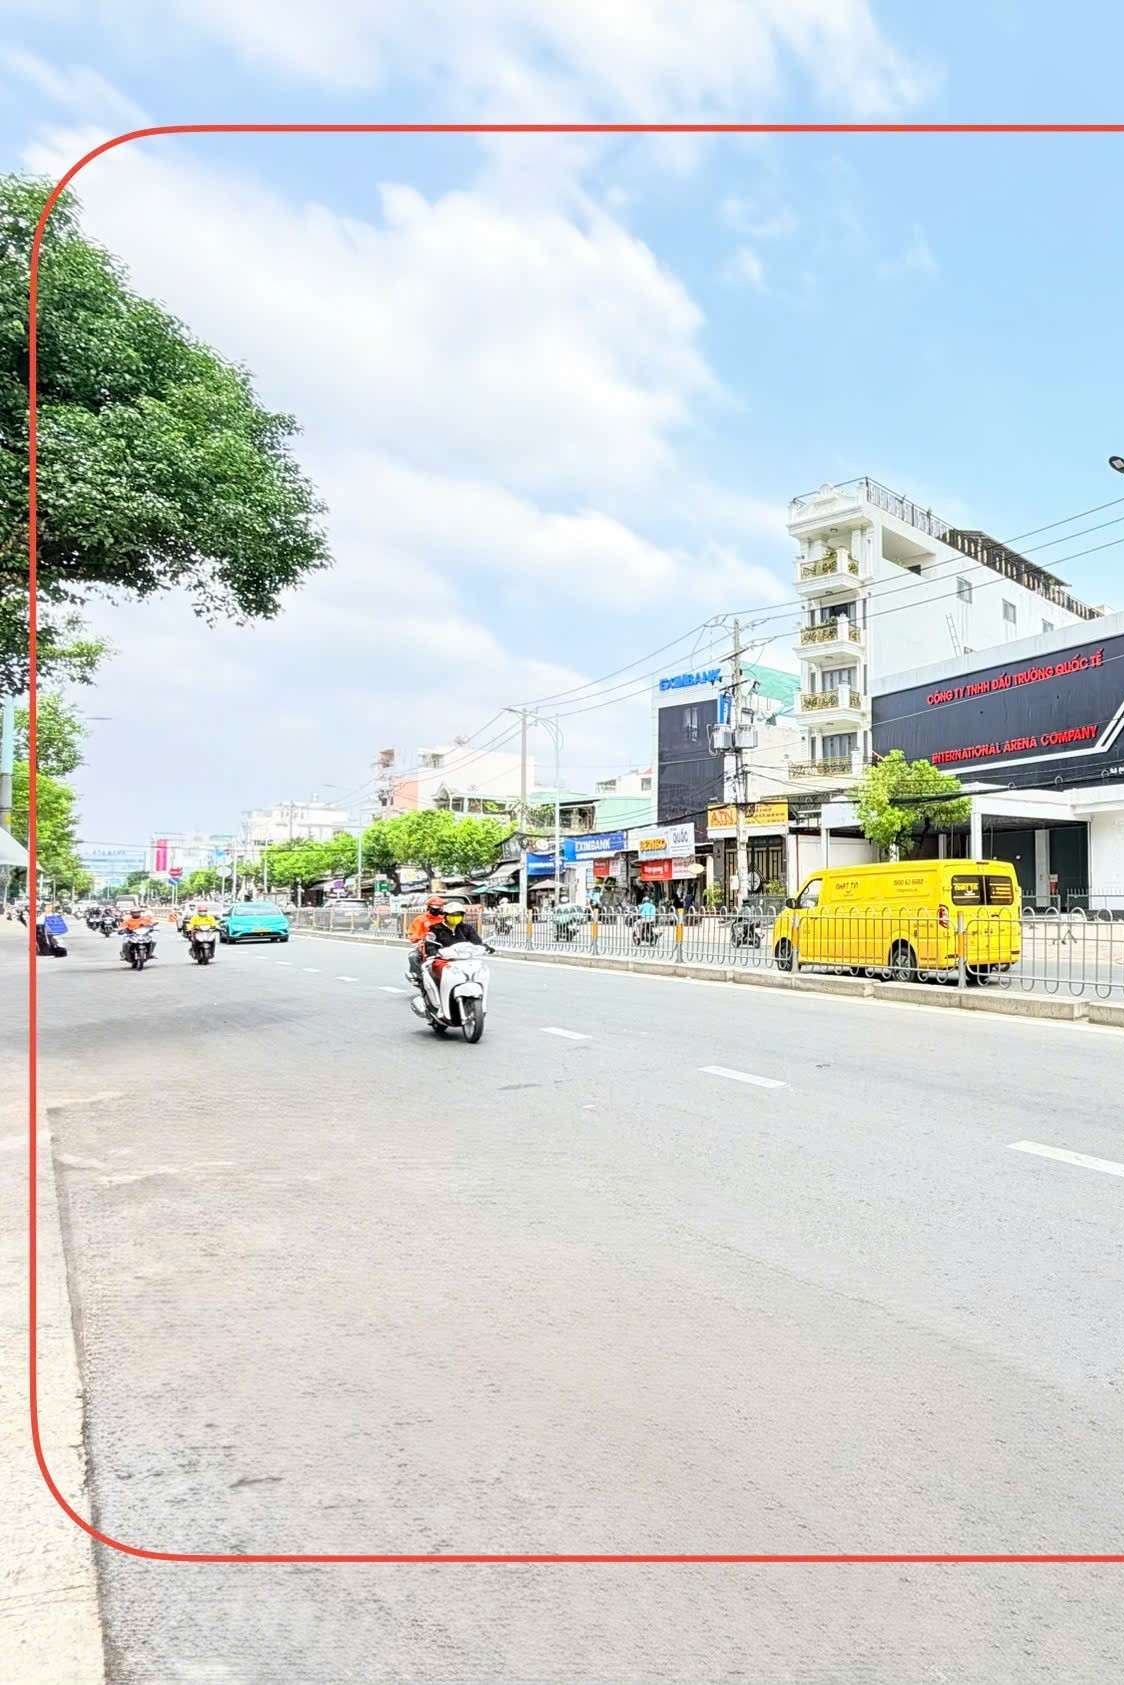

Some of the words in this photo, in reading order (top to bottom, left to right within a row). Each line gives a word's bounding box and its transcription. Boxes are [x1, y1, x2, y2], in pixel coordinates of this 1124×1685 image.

[659, 668, 721, 692] EXIMBANK
[927, 689, 954, 705] CÔNG
[953, 687, 967, 700] TY
[966, 680, 990, 697] TNHH
[991, 672, 1012, 690] ĐẤU
[1012, 665, 1055, 686] TRƯỜNG
[1055, 654, 1089, 676] QUỐC
[1089, 648, 1105, 667] TẾ
[931, 742, 1002, 764] INTERNATIONAL
[1003, 735, 1038, 753] ARENA
[1040, 724, 1099, 746] COMPANY
[575, 838, 611, 851] EXIMBANK
